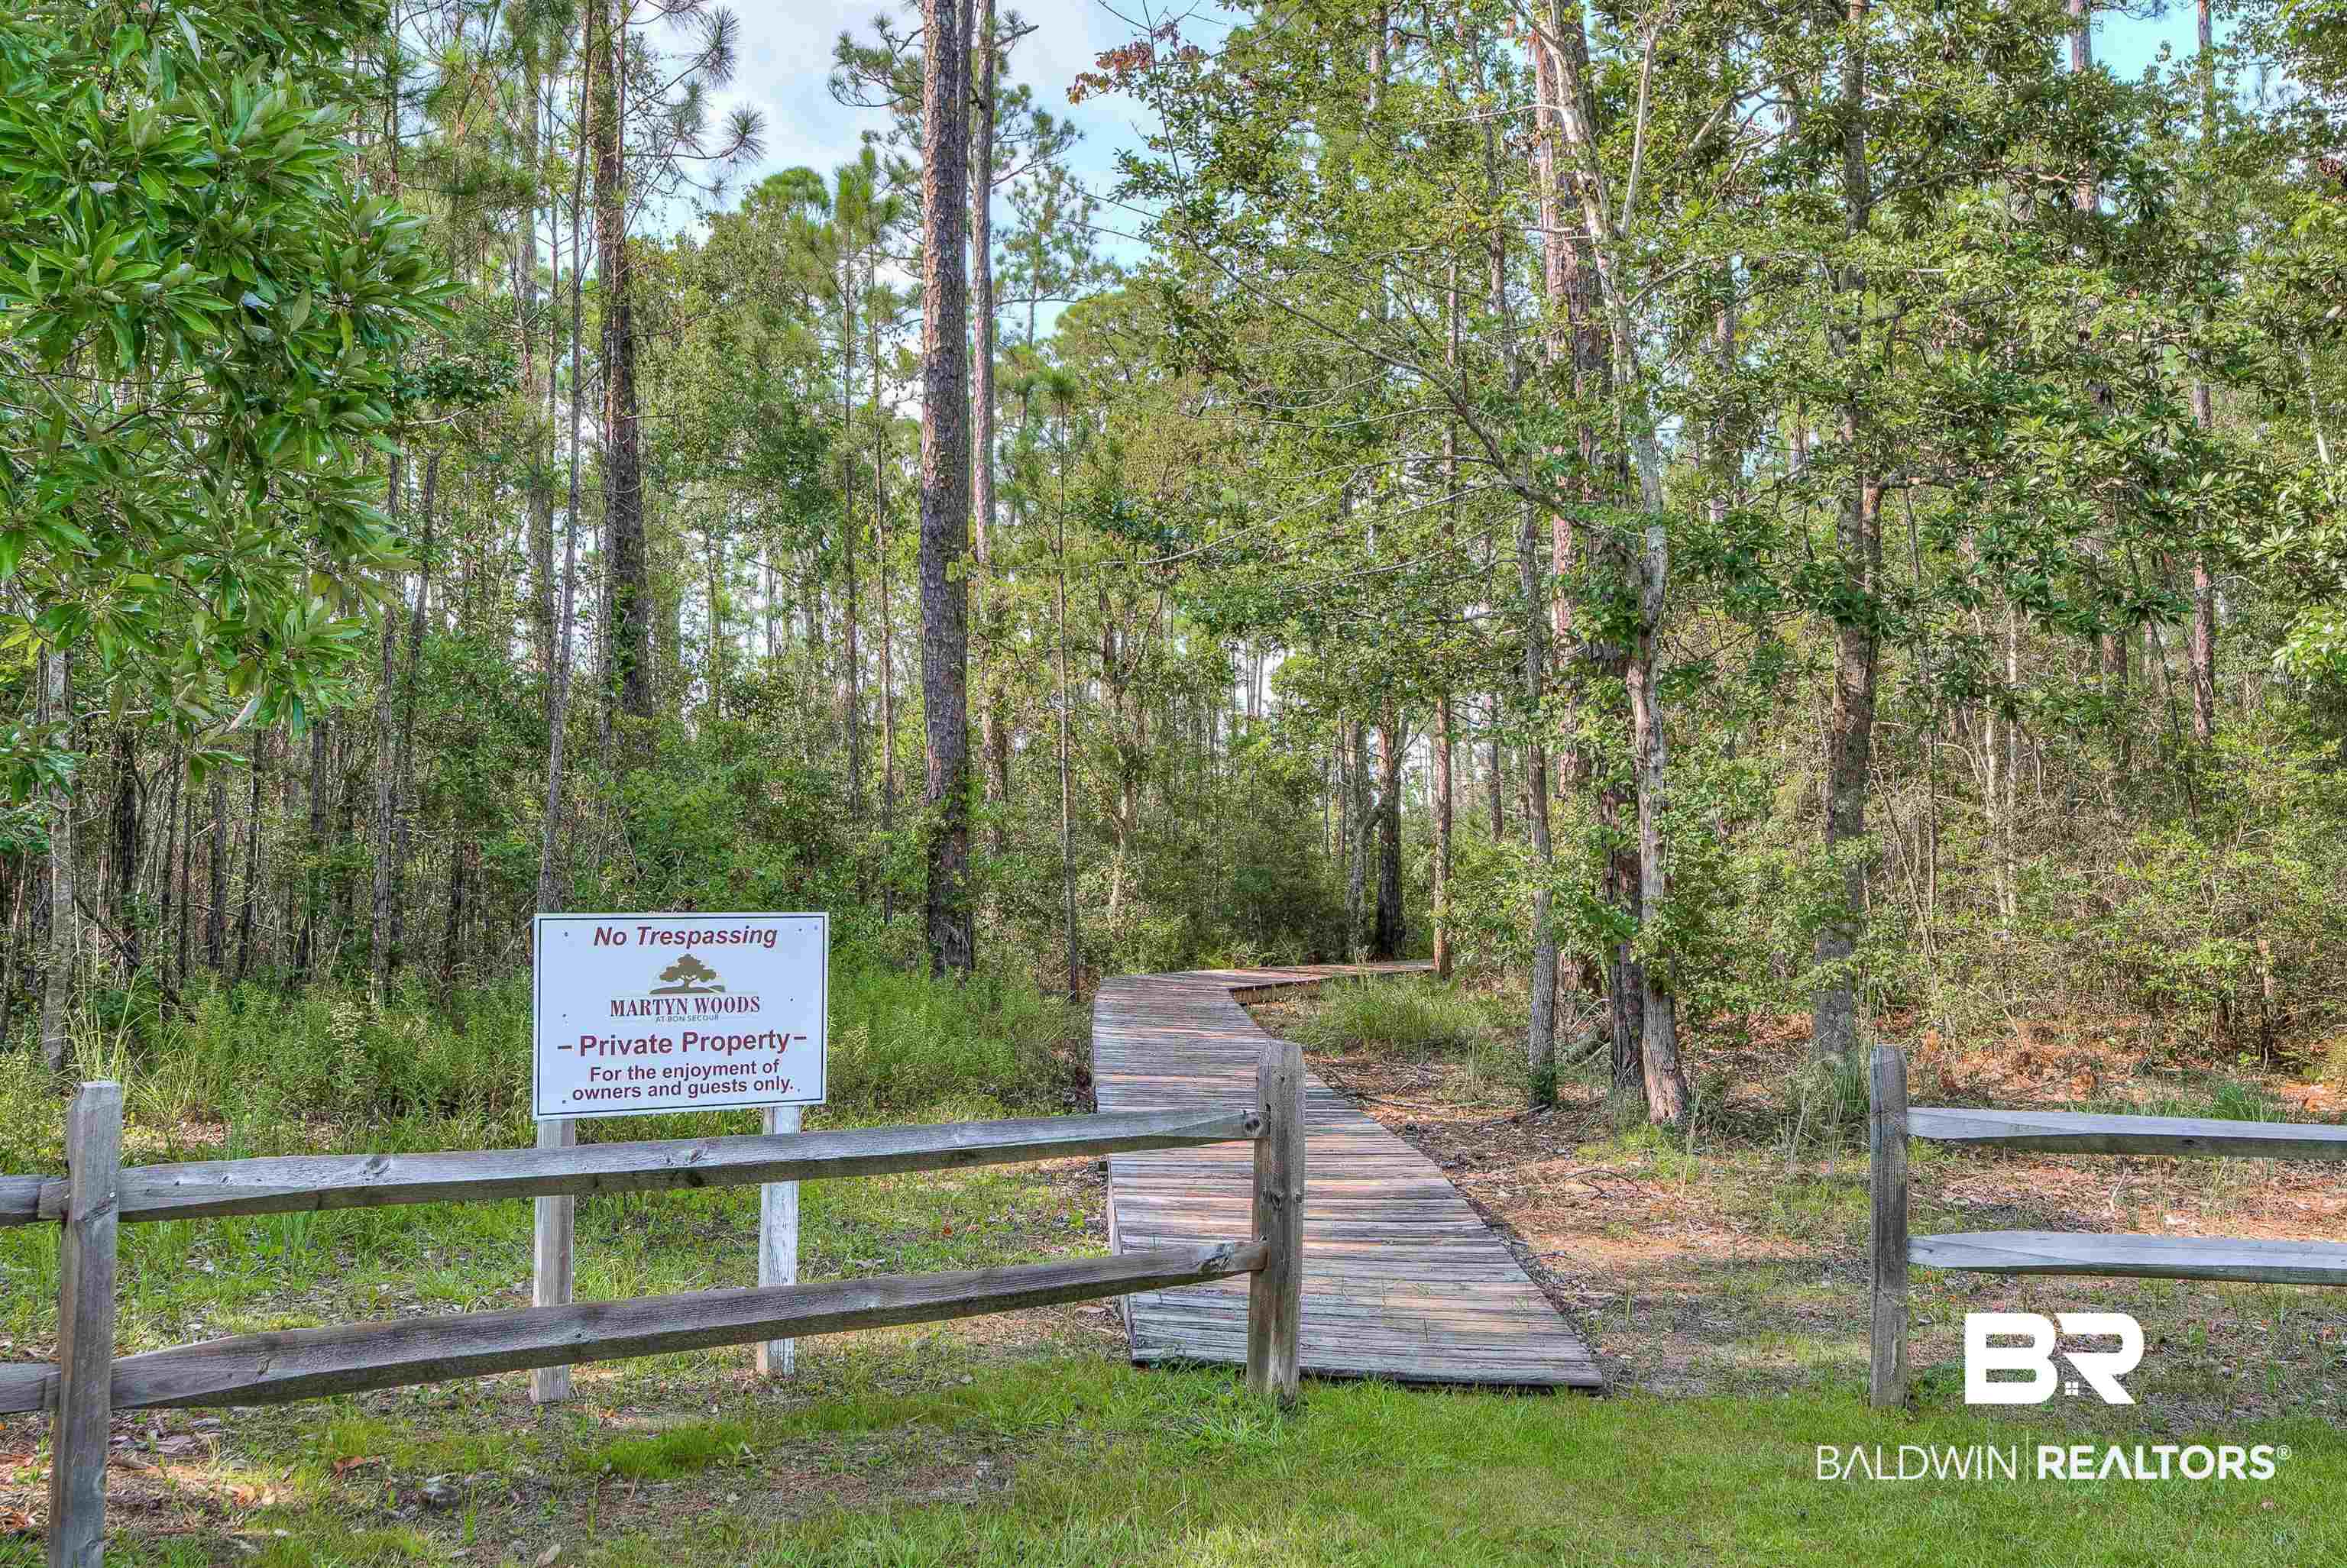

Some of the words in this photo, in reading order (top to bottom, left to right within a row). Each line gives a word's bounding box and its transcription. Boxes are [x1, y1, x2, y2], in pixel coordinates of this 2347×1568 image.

[594, 926, 627, 946] No
[637, 925, 778, 949] Trespassing
[610, 997, 688, 1017] MARTYN
[694, 996, 761, 1014] WOODS
[590, 1066, 622, 1082] For
[628, 1065, 656, 1080] the
[662, 1061, 756, 1081] enjoyment
[762, 1059, 780, 1074] of
[572, 1085, 641, 1101] owners
[648, 1081, 681, 1097] and
[688, 1081, 747, 1098] guests
[753, 1075, 793, 1094] only.
